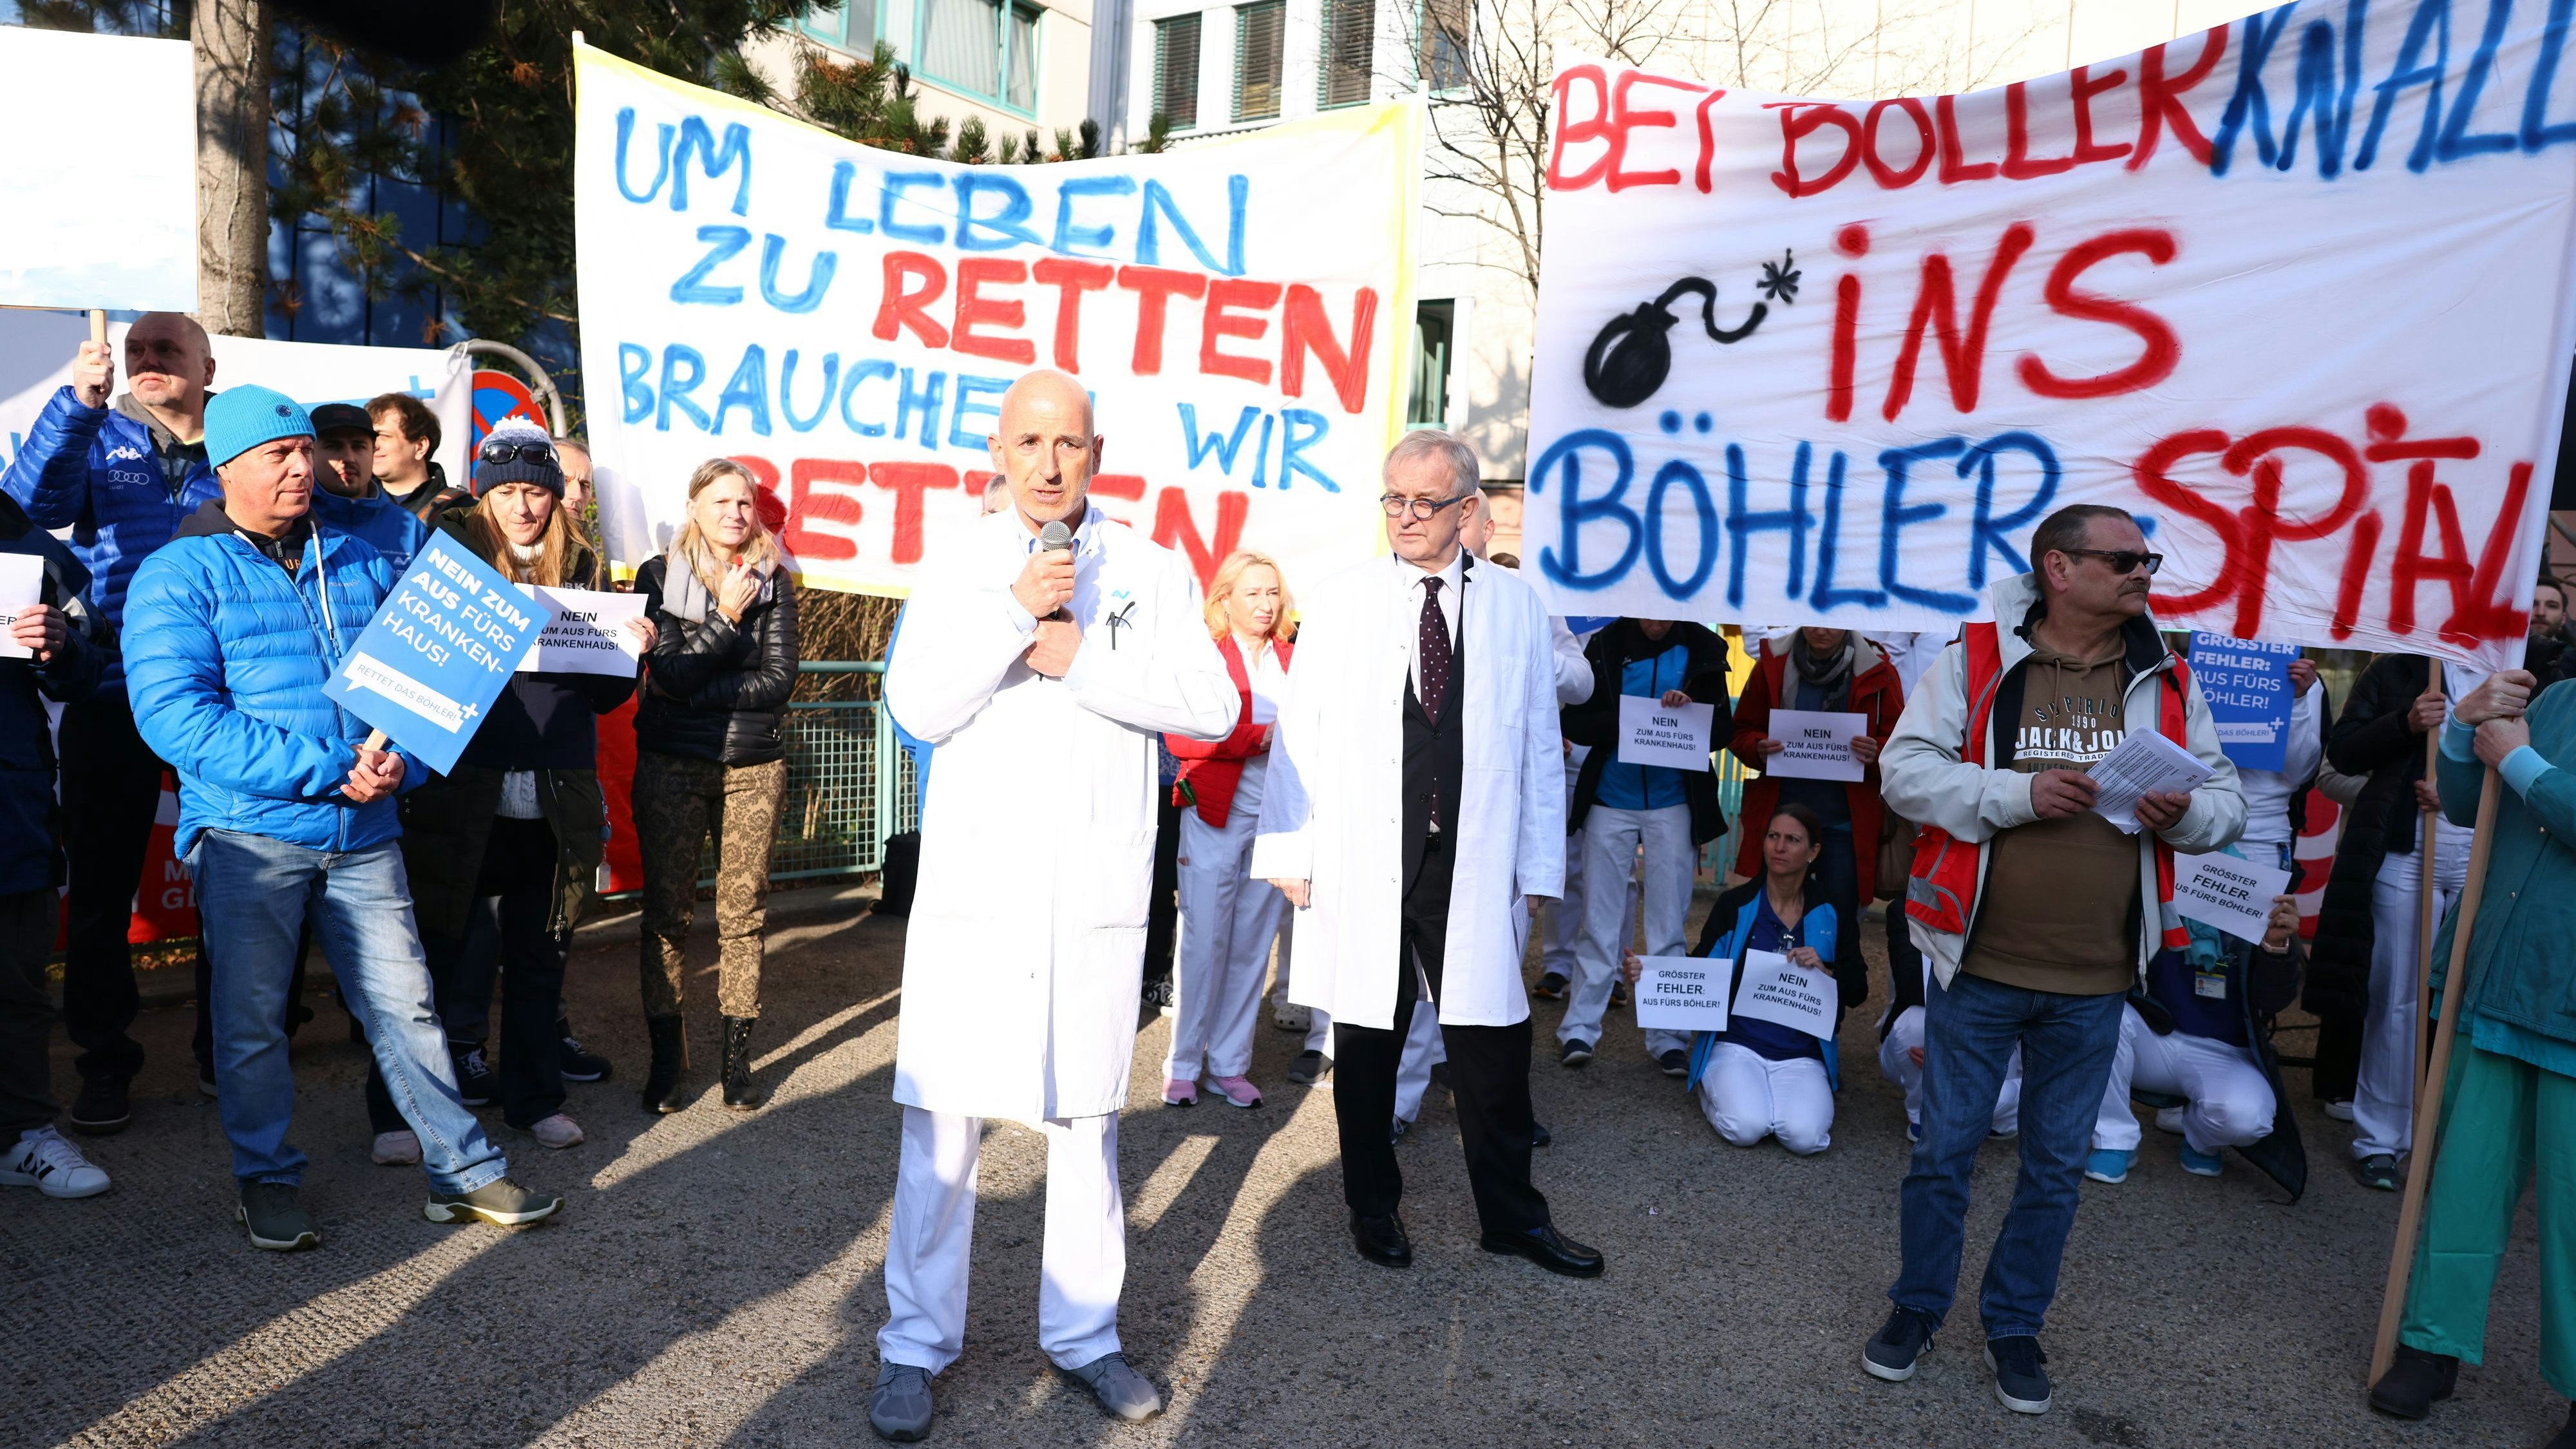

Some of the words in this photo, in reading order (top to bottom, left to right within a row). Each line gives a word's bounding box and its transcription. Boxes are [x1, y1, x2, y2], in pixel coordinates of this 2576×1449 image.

[1546, 64, 1726, 194] BEI
[616, 107, 751, 216] UM
[826, 160, 1249, 277] LEBEN
[670, 225, 837, 314] ZU
[873, 251, 1378, 414] RETTEN
[619, 342, 1095, 450] BRAUCHE
[1177, 402, 1341, 493] WIR
[427, 547, 482, 595] NEIN
[481, 589, 531, 633] ZUM
[411, 571, 460, 610] AUS
[460, 604, 515, 652] FÜRS
[560, 611, 597, 622] NEIN
[381, 611, 450, 667] HAUS!
[397, 589, 505, 674] KRANKEN-
[587, 626, 617, 637] FÜRS
[533, 638, 618, 650] RANKENHAUS!
[2194, 650, 2271, 672] FEHLER:
[357, 663, 393, 687] RETTET
[394, 682, 416, 699] DAS
[416, 693, 457, 721] BÖHLER!
[2195, 670, 2228, 685] AUS
[2233, 673, 2281, 692] FÜRS
[2203, 687, 2269, 709] ÖHLER!
[1653, 716, 1678, 727] NEIN
[2072, 714, 2097, 729] 1990
[1634, 738, 1696, 751] KRANKENHAUS!
[1673, 732, 1694, 741] FÜRS
[1804, 728, 1832, 739] NEIN
[1783, 751, 1850, 762] KRANKENHAUS!
[1826, 743, 1848, 752] FÜRS
[2023, 750, 2074, 759] REGISTERED
[2202, 864, 2258, 887] GRÖSSTER
[2192, 874, 2251, 902] FEHLER:
[2175, 883, 2189, 893] US
[2190, 889, 2217, 903] FÜRS
[2218, 899, 2264, 919] BÖHLER!
[1658, 969, 1706, 980] GRÖSSTER
[1779, 972, 1808, 988] NEIN
[1657, 983, 1705, 994] FEHLER:
[1758, 983, 1777, 992] ZUM
[1778, 987, 1797, 997] AUS
[1799, 992, 1822, 1006] FÜRS
[1660, 998, 1681, 1007] FÜRS
[1683, 999, 1720, 1008] BÖHLER!
[1753, 992, 1822, 1016] KRANKENHAUS!
